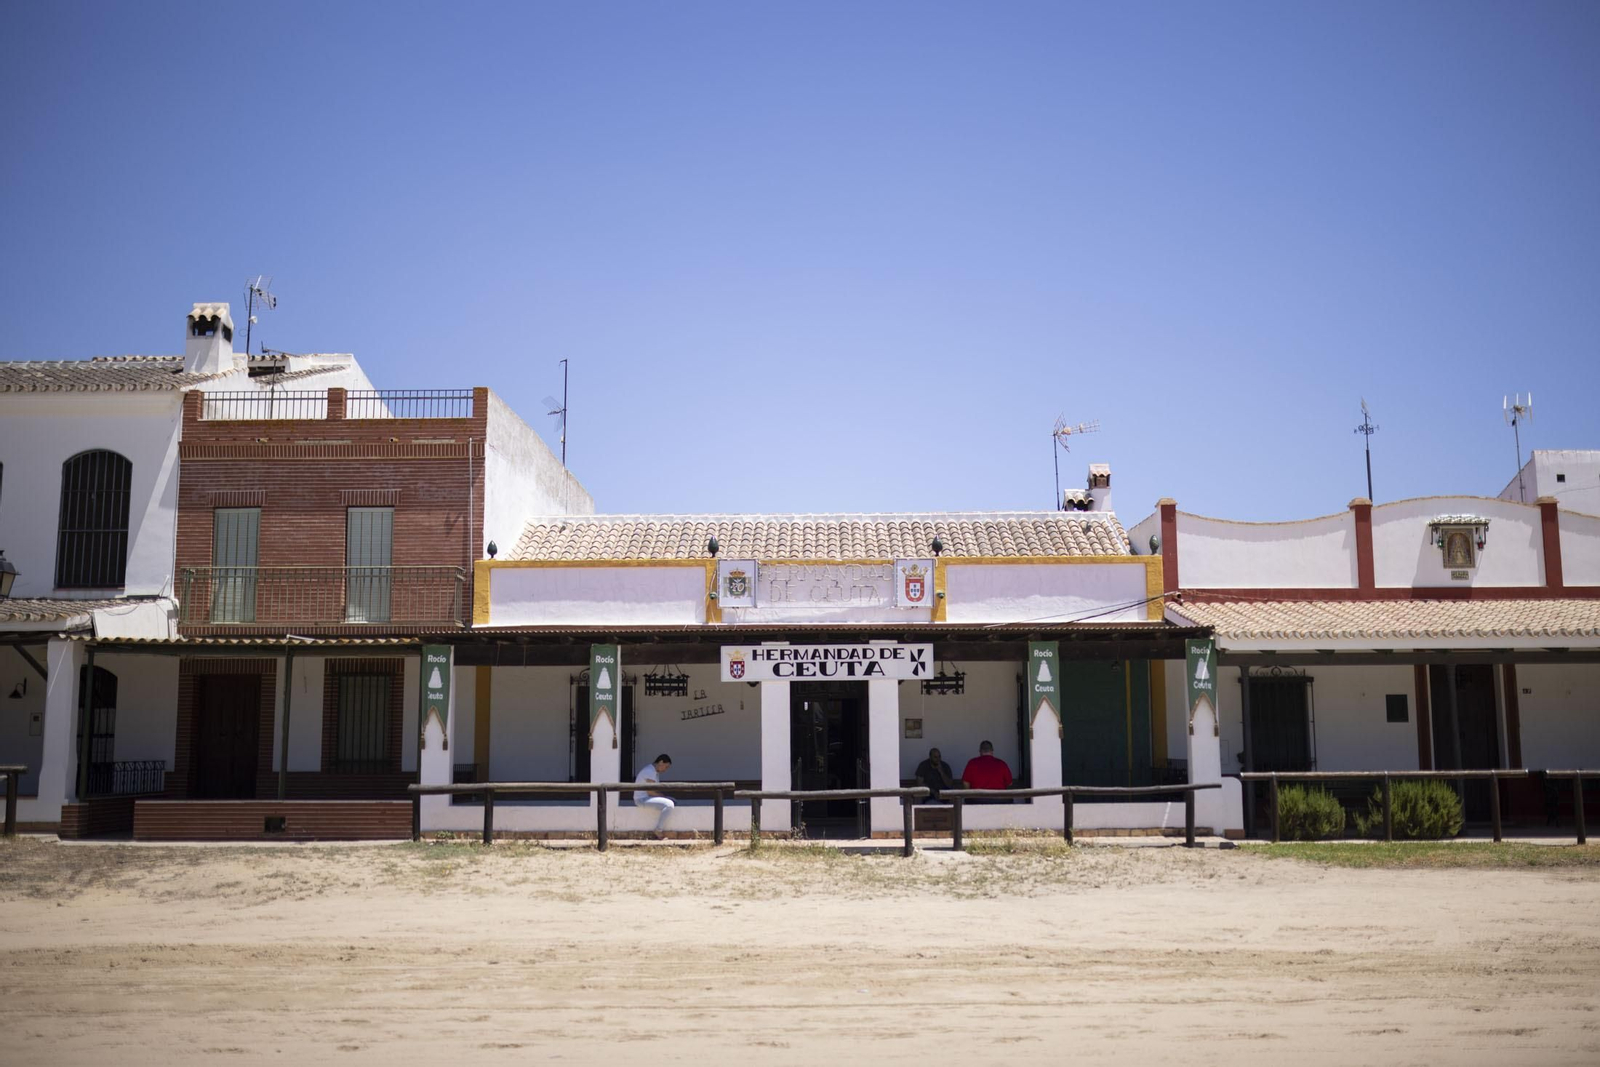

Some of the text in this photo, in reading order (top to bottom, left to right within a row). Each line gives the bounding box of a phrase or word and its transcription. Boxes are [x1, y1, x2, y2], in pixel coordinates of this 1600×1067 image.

[770, 584, 880, 602] DE CEUTA
[752, 647, 905, 661] HERMANDAD DE
[1033, 649, 1053, 657] Rocío
[428, 654, 447, 663] Rocío
[595, 655, 614, 664] Rocío
[772, 661, 885, 677] CEUTA
[1034, 684, 1054, 692] Ceuta
[595, 692, 613, 700] Ceuta
